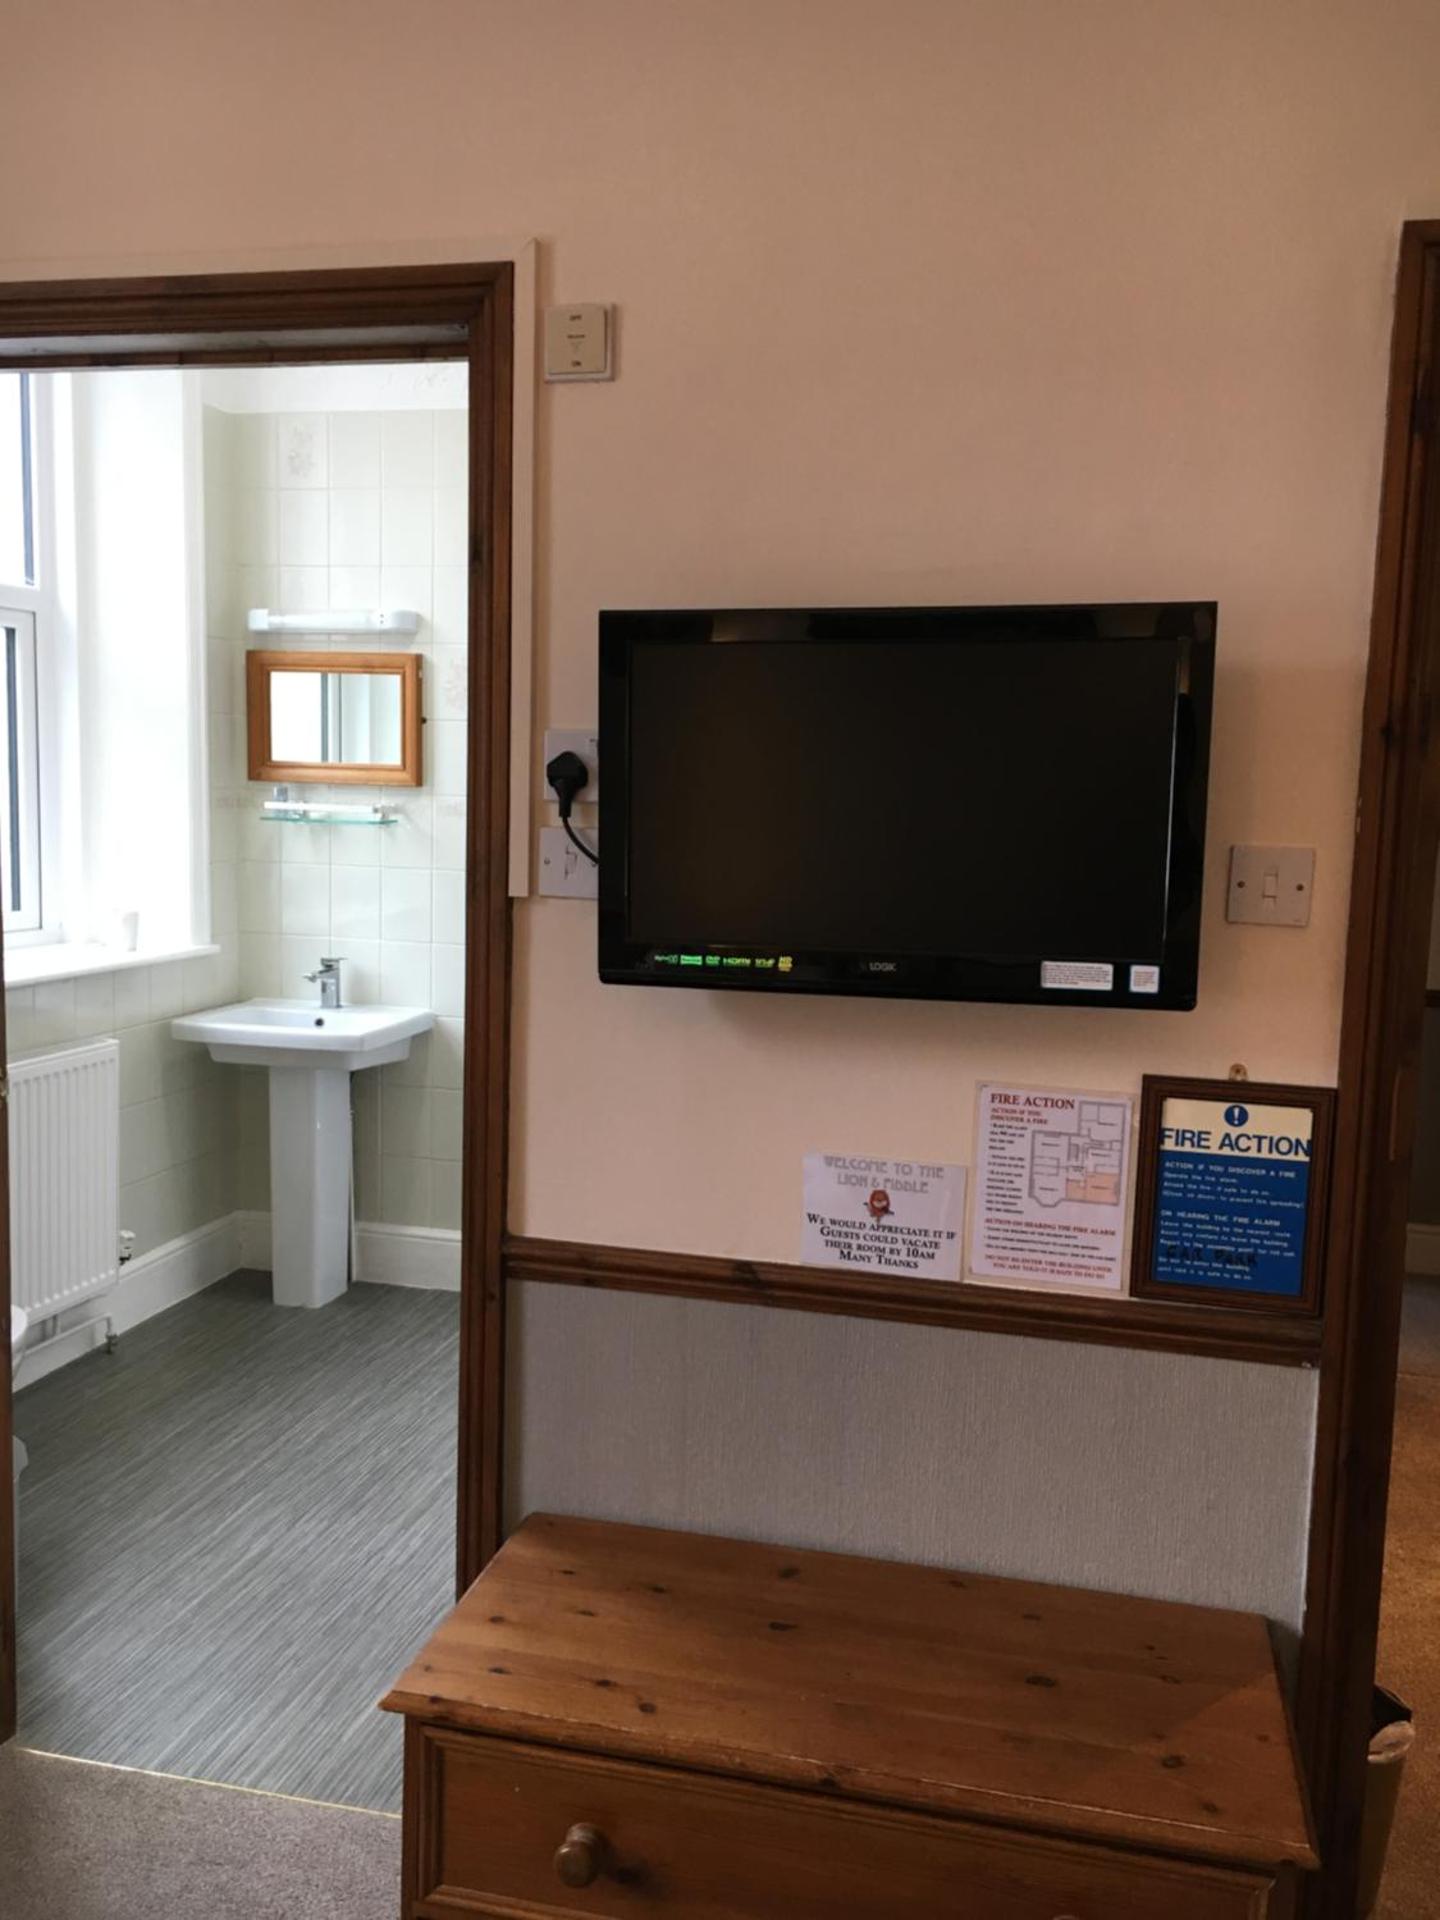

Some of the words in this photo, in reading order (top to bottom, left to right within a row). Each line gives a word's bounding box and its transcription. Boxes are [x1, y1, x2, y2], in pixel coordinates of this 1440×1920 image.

[990, 1092, 1020, 1105] FIRE
[1023, 1096, 1075, 1110] ACTION
[1160, 1127, 1212, 1150] FIRE
[1218, 1132, 1313, 1157] ACTION
[823, 1155, 888, 1174] WELCOME
[894, 1163, 913, 1176] TO
[919, 1164, 945, 1179] THE
[837, 1173, 868, 1187] LION
[870, 1177, 880, 1188] &
[883, 1177, 930, 1194] FIDDLE
[807, 1212, 826, 1226] WE
[829, 1218, 867, 1231] WOULD
[869, 1223, 930, 1238] APPRECIATE
[933, 1230, 943, 1239] IT
[946, 1232, 957, 1240] IF
[820, 1226, 861, 1240] GUESTS
[863, 1233, 899, 1245] COULD
[901, 1238, 941, 1250] VACATE
[824, 1239, 854, 1250] THEIR
[856, 1243, 887, 1255] ROOM
[889, 1248, 902, 1257] BY
[905, 1247, 936, 1260] 10AM
[839, 1250, 873, 1264] MANY
[876, 1255, 919, 1270] THANKS
